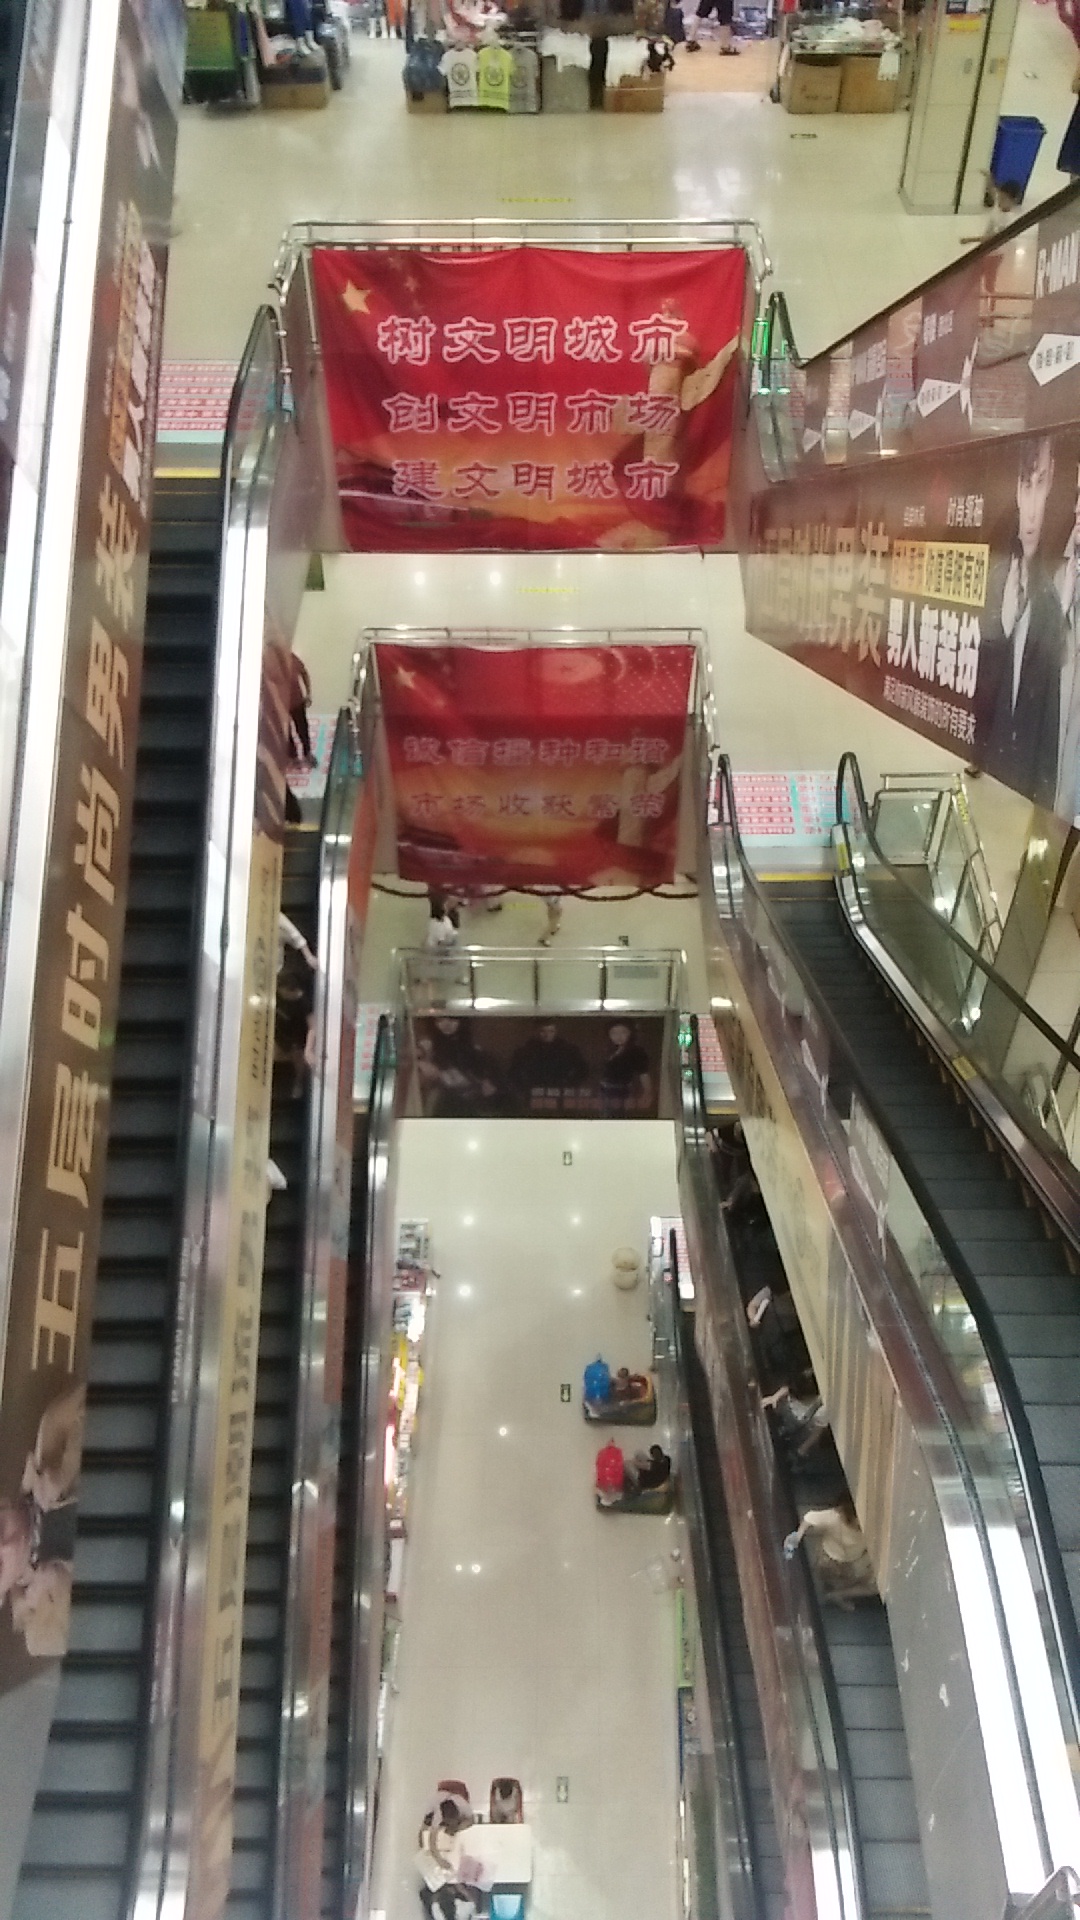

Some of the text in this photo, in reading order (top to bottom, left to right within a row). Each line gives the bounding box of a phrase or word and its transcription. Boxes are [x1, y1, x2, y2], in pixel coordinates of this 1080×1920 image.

[377, 314, 689, 366] 树文明城市
[382, 389, 683, 436] 创文明市场
[392, 459, 680, 501] 建文明城市
[887, 597, 981, 699] 男人新装扮
[31, 473, 138, 1373] 五层时尚男装
